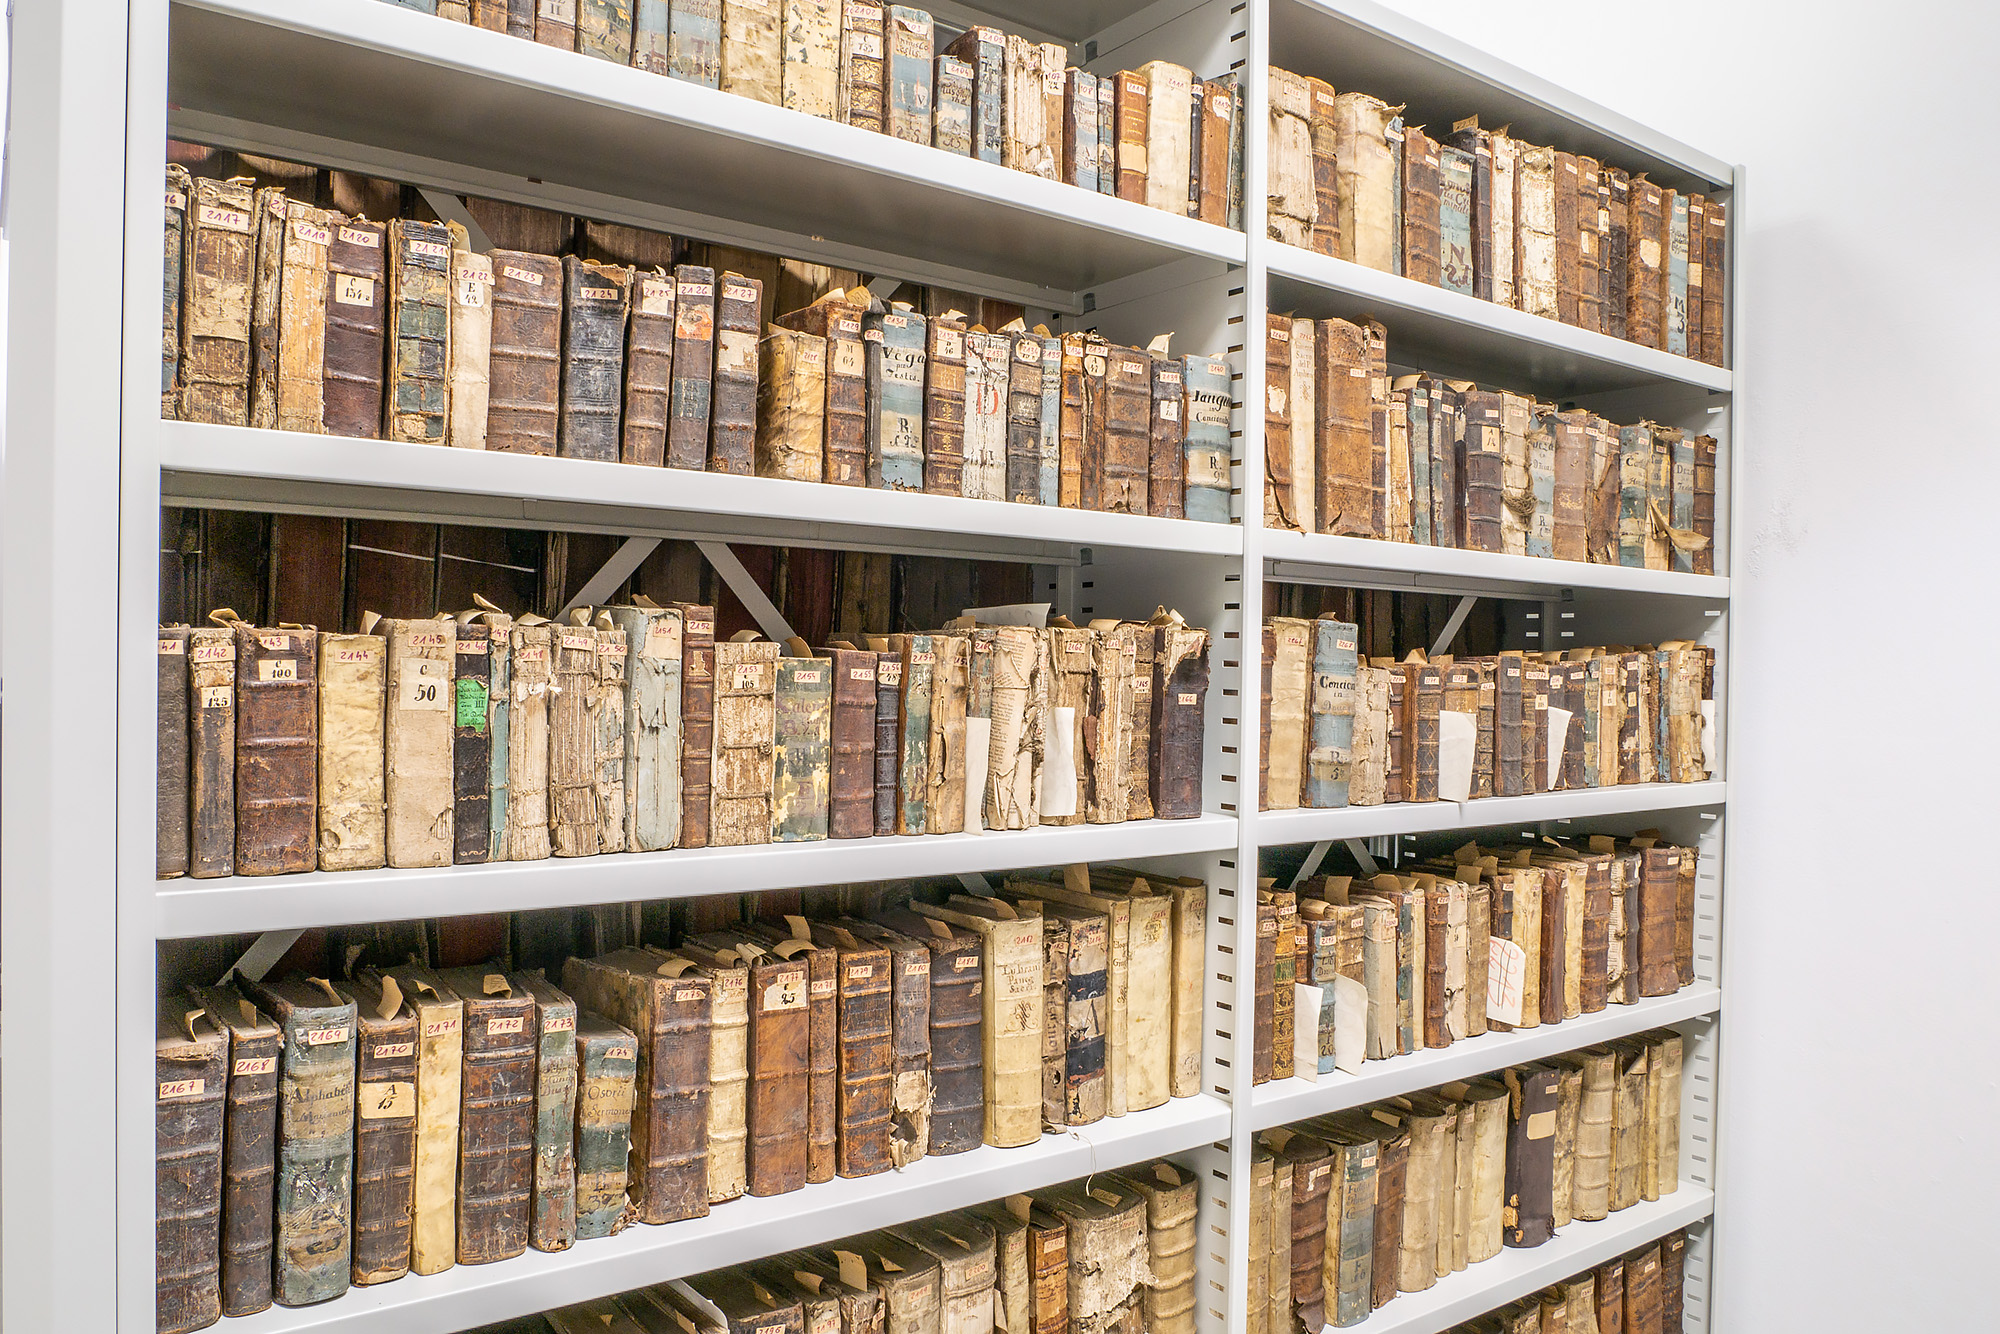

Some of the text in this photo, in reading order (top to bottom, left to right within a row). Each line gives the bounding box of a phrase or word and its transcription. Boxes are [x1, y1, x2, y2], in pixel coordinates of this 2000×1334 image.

[207, 210, 241, 225] 2117
[299, 225, 326, 243] 2119
[342, 230, 370, 244] 2120
[416, 243, 444, 254] 2121
[463, 270, 489, 282] 2122
[508, 268, 537, 283] 2123
[470, 282, 476, 293] E
[682, 284, 708, 296] 2126
[585, 289, 613, 300] 2124
[644, 289, 670, 299] 2125
[727, 289, 754, 300] 2127
[842, 321, 860, 332] 2129
[690, 621, 710, 631] 2152
[412, 634, 443, 646] 2145
[564, 636, 588, 647] 2149
[458, 641, 486, 651] 2146
[599, 644, 625, 653] 2150
[198, 647, 227, 659] 2142
[340, 651, 368, 663] 2144
[520, 650, 544, 660] 2148
[913, 653, 932, 662] 2157
[272, 668, 292, 678] 100
[420, 664, 428, 676] C
[737, 665, 758, 674] 2153
[881, 663, 900, 672] 2156
[796, 672, 816, 681] 2154
[852, 670, 872, 679] 2155
[742, 680, 755, 689] 105
[414, 684, 437, 702] 50
[208, 697, 228, 707] 125
[1016, 935, 1034, 945] 2182
[850, 966, 869, 977] 2179
[725, 977, 743, 988] 2176
[779, 972, 798, 983] 2177
[812, 980, 833, 991] 2178
[678, 990, 700, 1000] 2175
[427, 1020, 457, 1034] 2171
[489, 1020, 519, 1032] 2172
[544, 1017, 573, 1031] 2173
[310, 1030, 341, 1042] 2169
[375, 1044, 408, 1057] 2170
[236, 1059, 271, 1073] 2168
[162, 1081, 195, 1096] 2167
[384, 1084, 397, 1096] A
